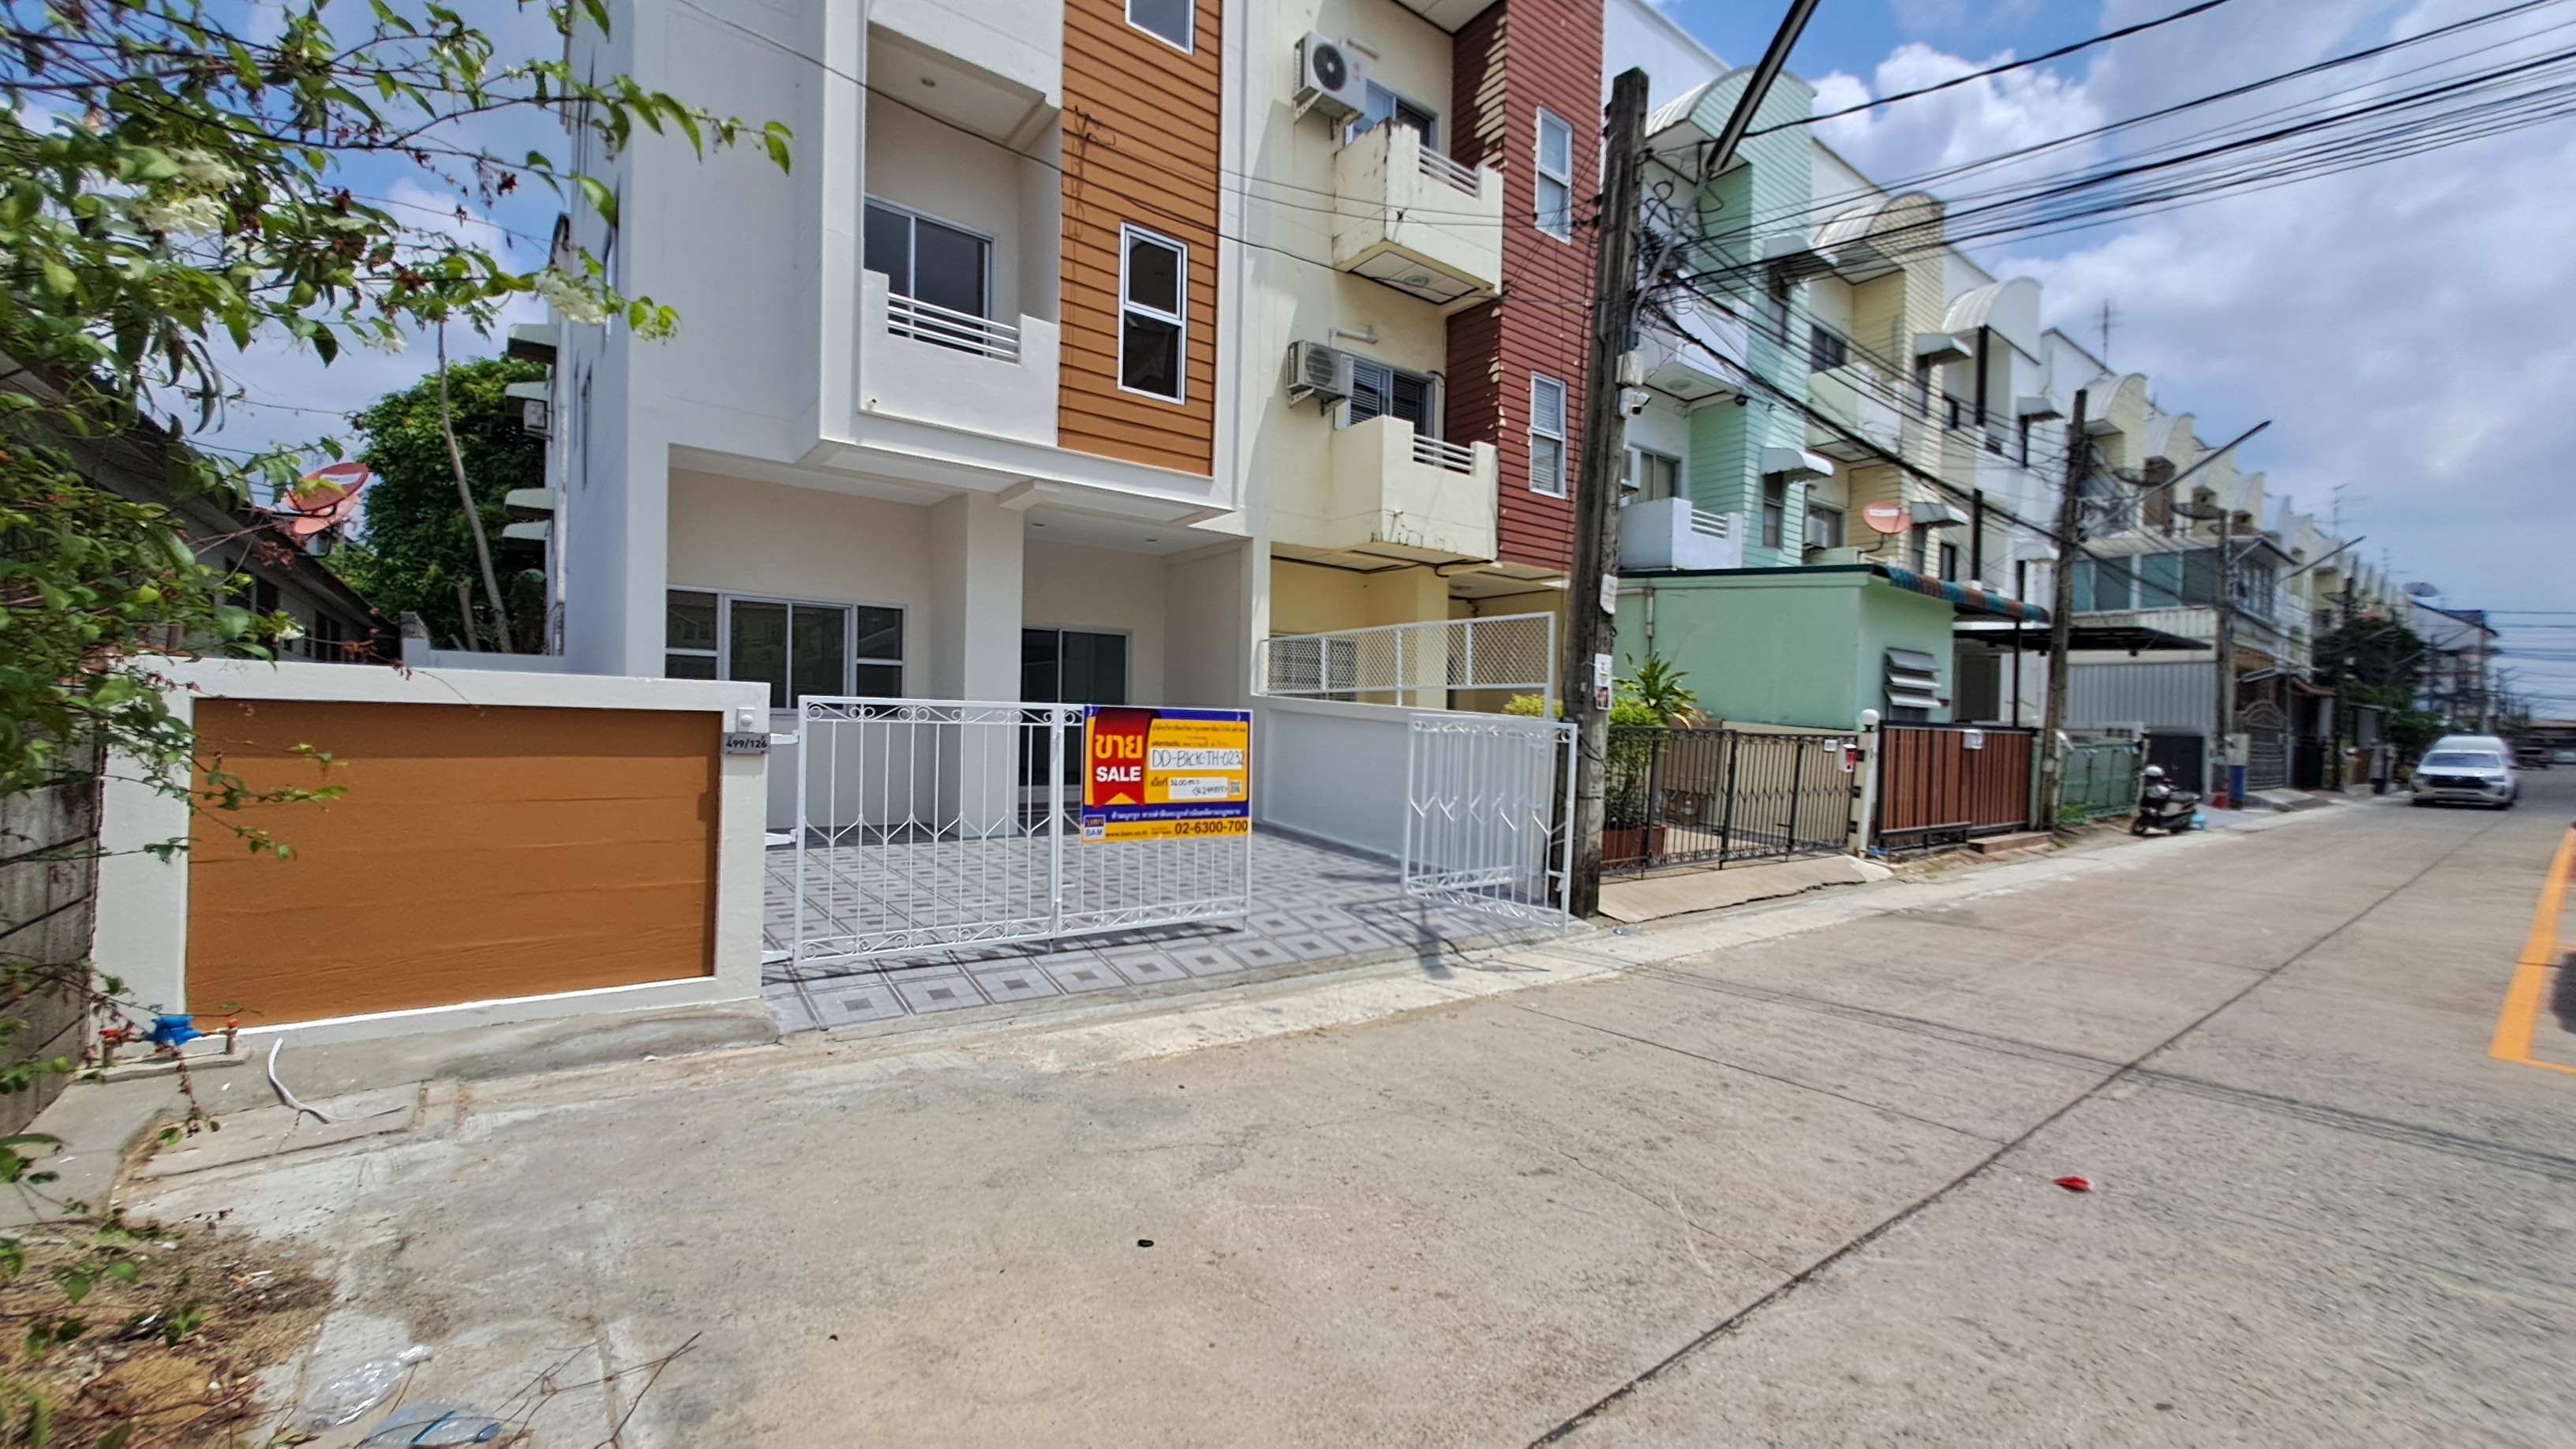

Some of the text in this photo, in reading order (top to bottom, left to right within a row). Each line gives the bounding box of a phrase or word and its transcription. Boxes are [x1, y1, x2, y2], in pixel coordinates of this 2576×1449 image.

[726, 739, 768, 749] 499/126
[1095, 734, 1143, 759] ขาย
[1095, 766, 1141, 782] SALE
[1085, 828, 1103, 837] BAM
[1174, 820, 1248, 835] 02-6300-700
